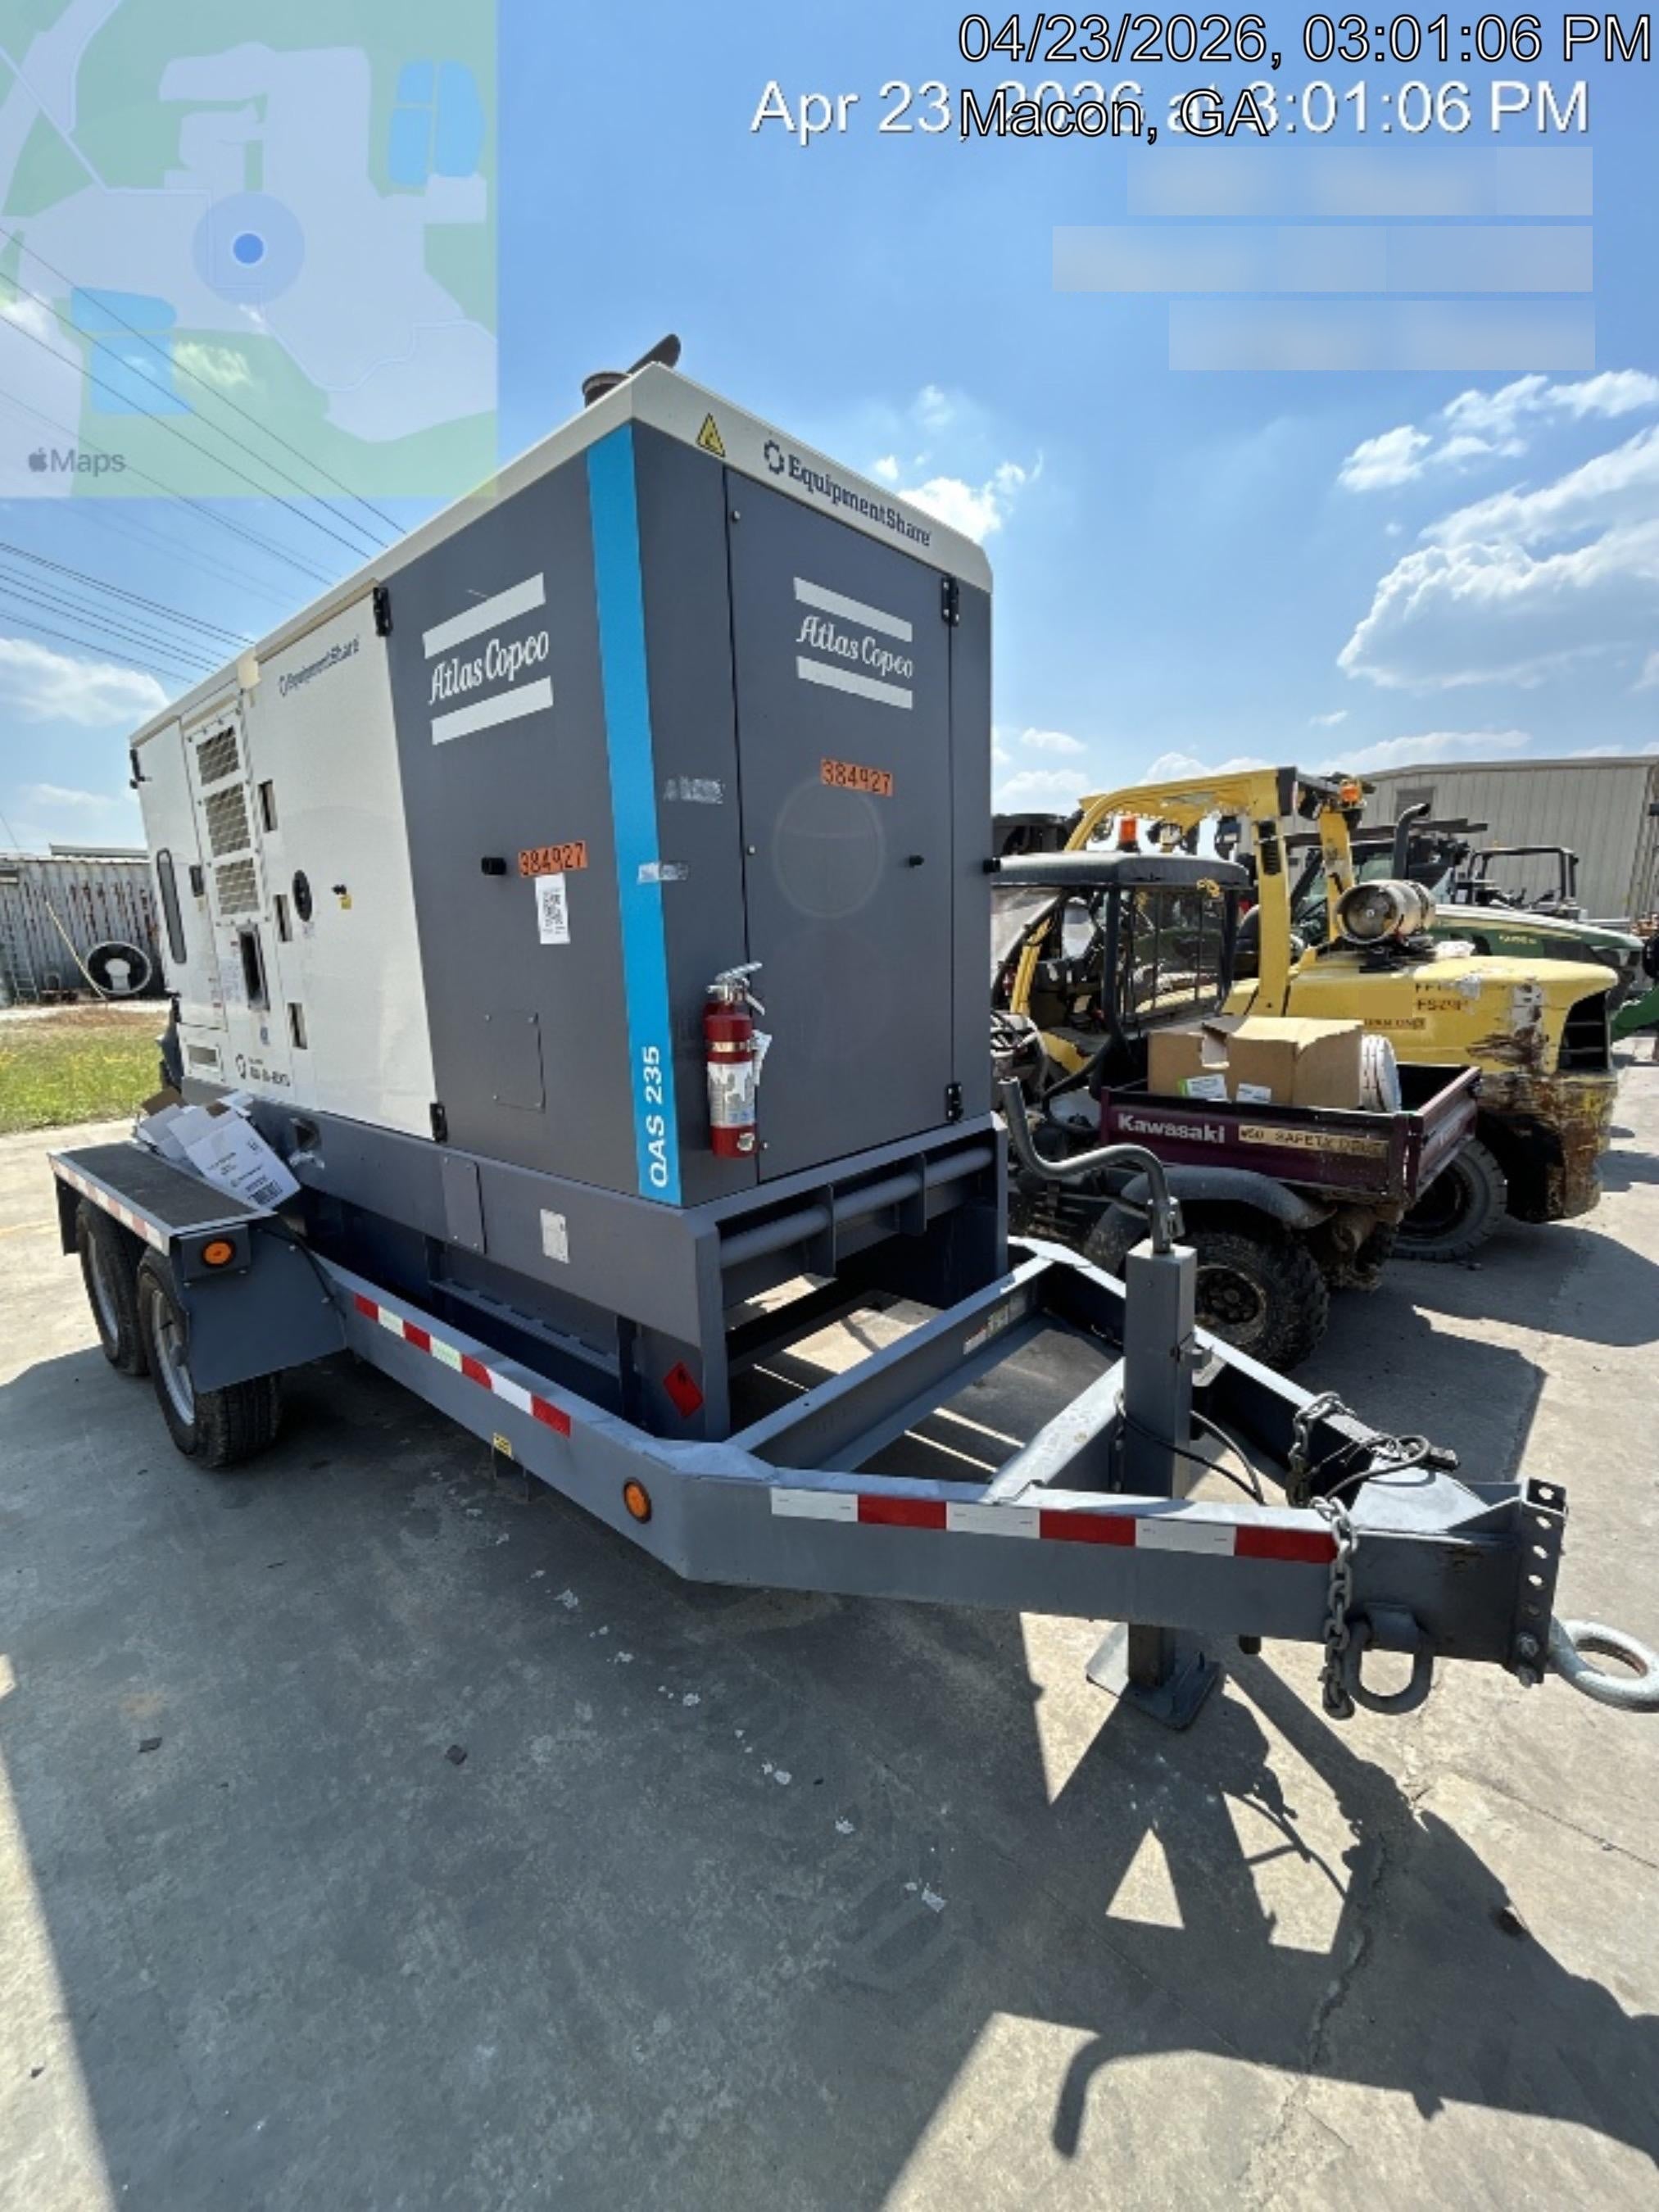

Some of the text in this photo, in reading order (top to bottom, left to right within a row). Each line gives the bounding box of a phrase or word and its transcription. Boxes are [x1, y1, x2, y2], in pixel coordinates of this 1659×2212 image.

[787, 453, 932, 546] EquipmentShare
[427, 630, 550, 706] Atlas Copco
[796, 614, 914, 679] Atlas Copco
[823, 760, 891, 795] 384927
[519, 841, 584, 877] 384927
[641, 1045, 669, 1188] QAS 235
[1117, 1112, 1226, 1145] Kawasaki
